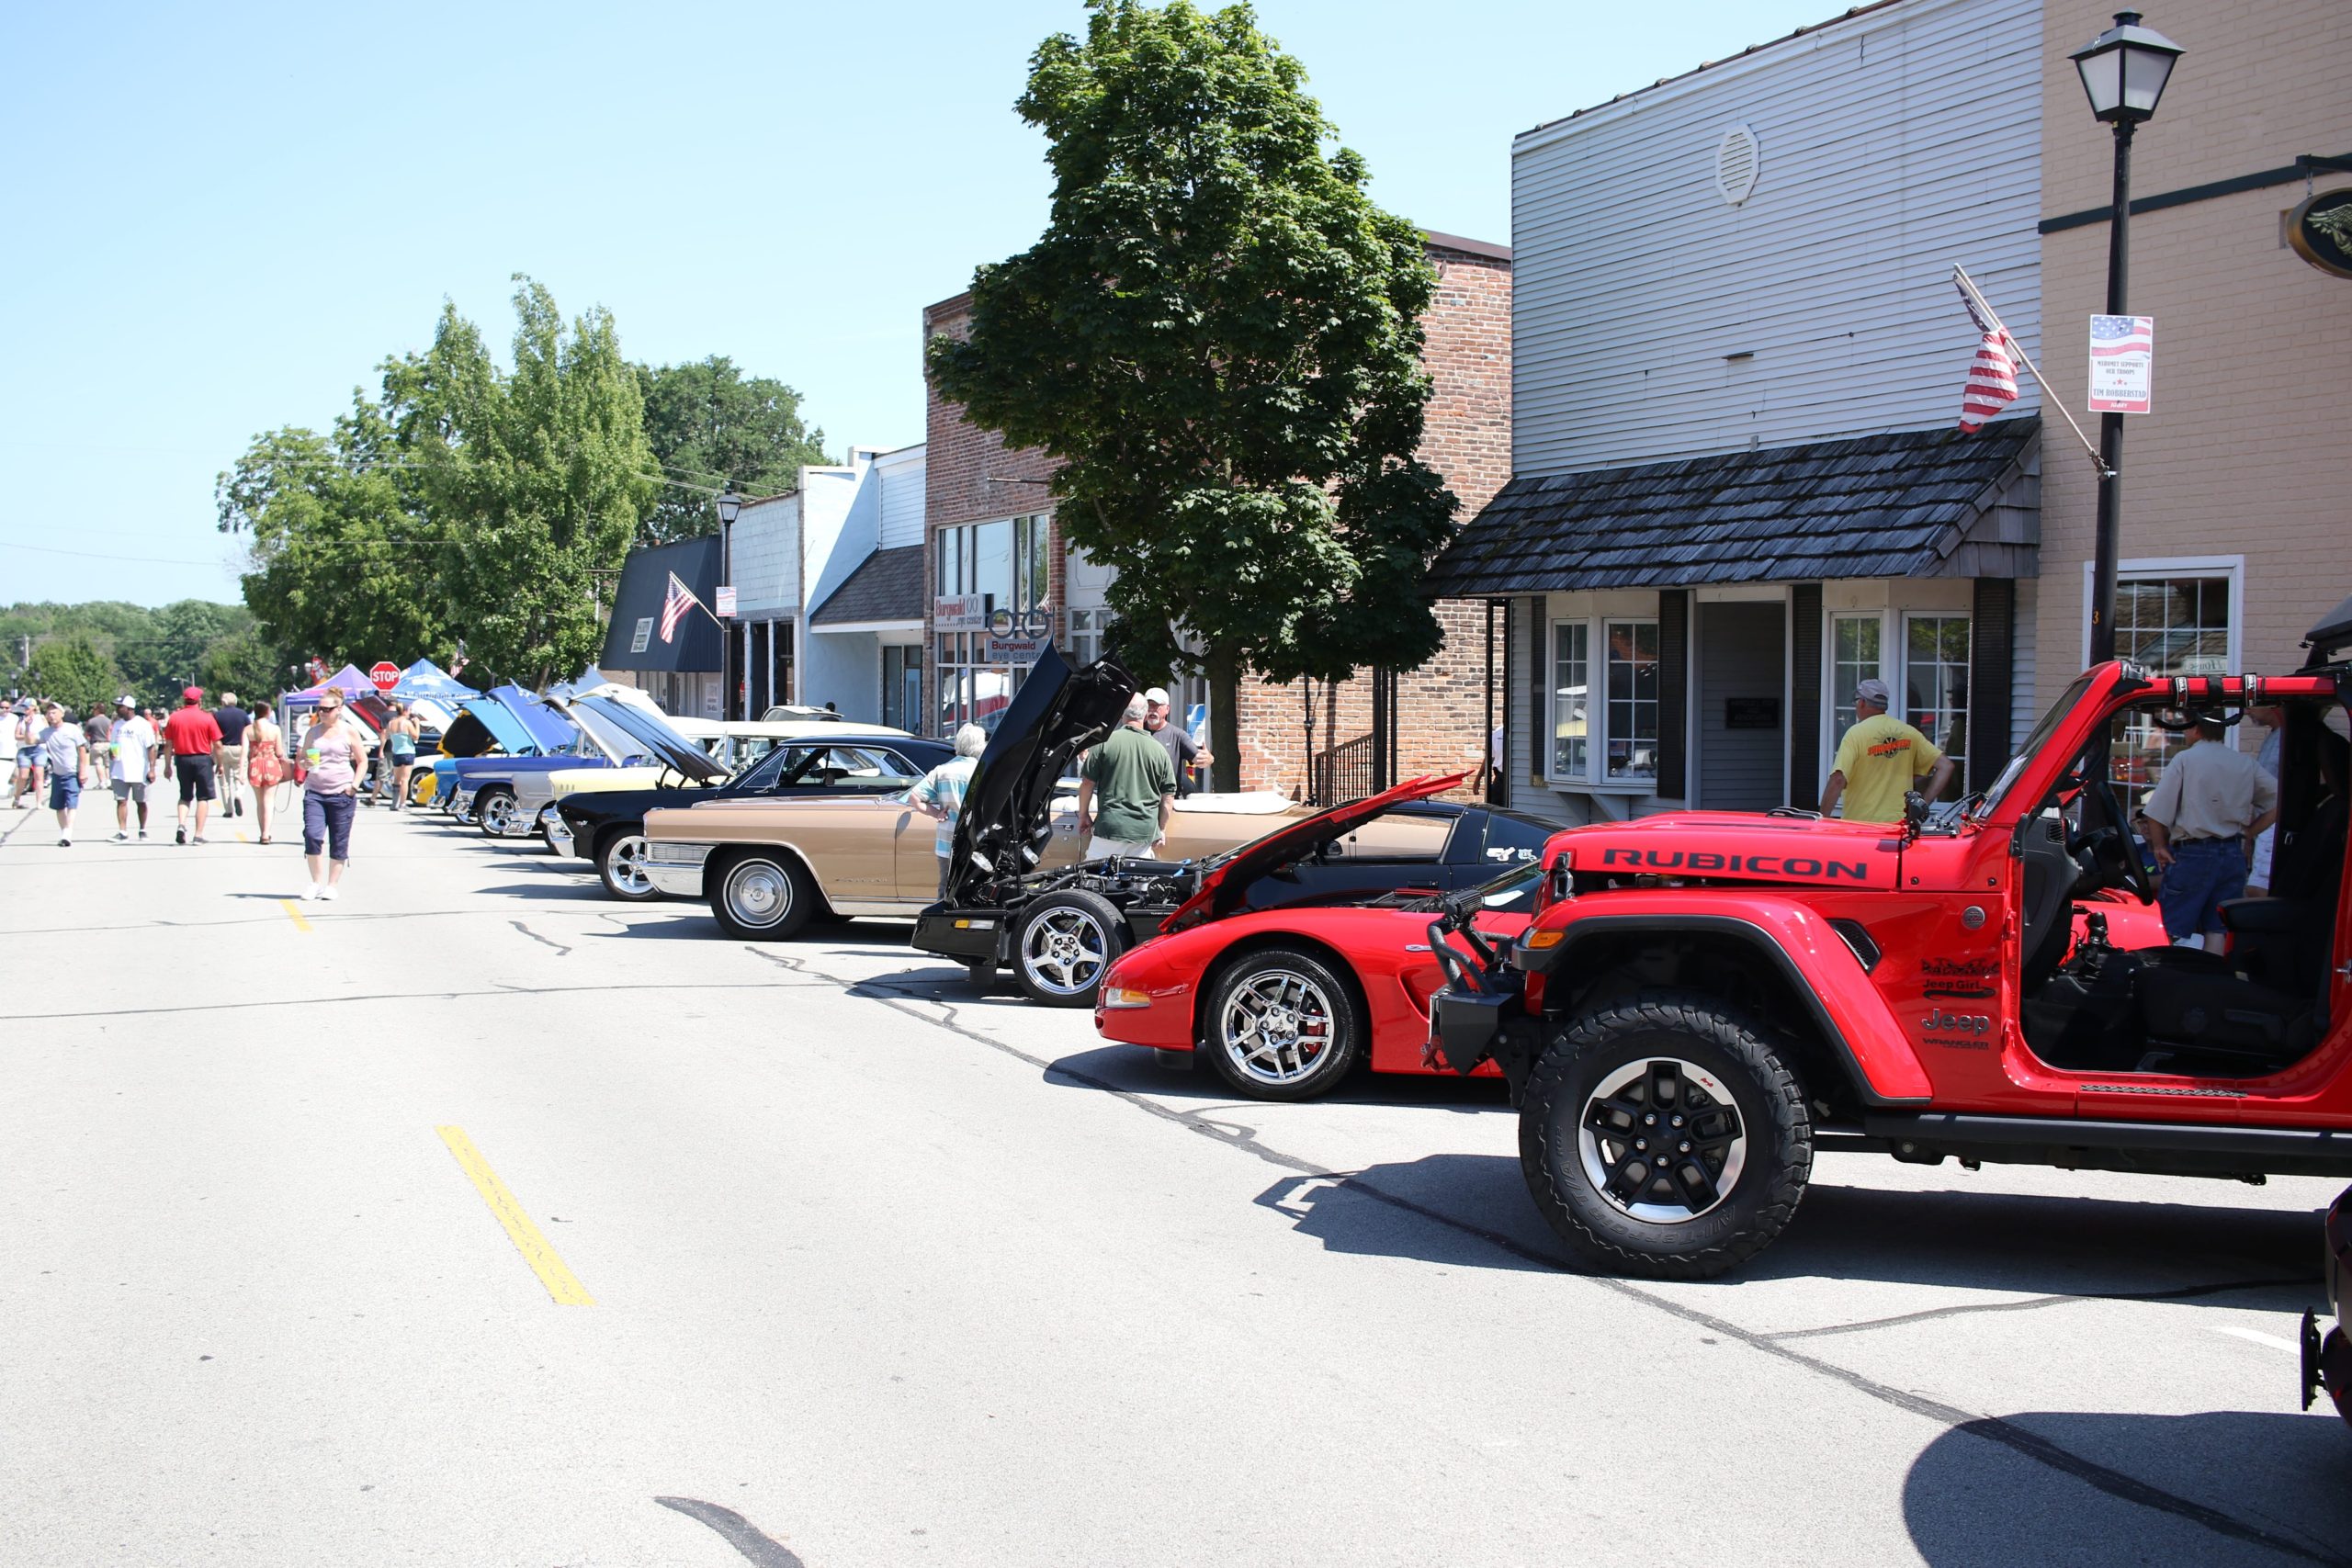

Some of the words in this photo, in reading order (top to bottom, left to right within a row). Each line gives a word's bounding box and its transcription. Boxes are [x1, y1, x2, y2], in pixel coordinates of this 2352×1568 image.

[2094, 389, 2104, 397] TIM
[2106, 389, 2147, 398] ROBBERSTAD
[935, 598, 966, 621] Burgwald
[967, 615, 983, 626] center
[2092, 610, 2099, 625] 3
[991, 641, 1035, 651] Burgwald
[992, 652, 1010, 661] eye
[1012, 651, 1041, 660] cente
[372, 671, 399, 682] STOP
[1603, 848, 1868, 880] RUBICON
[1923, 980, 1953, 989] Jeep
[1921, 1008, 1990, 1036] Jeep
[1923, 1038, 1989, 1048] WRANGLER
